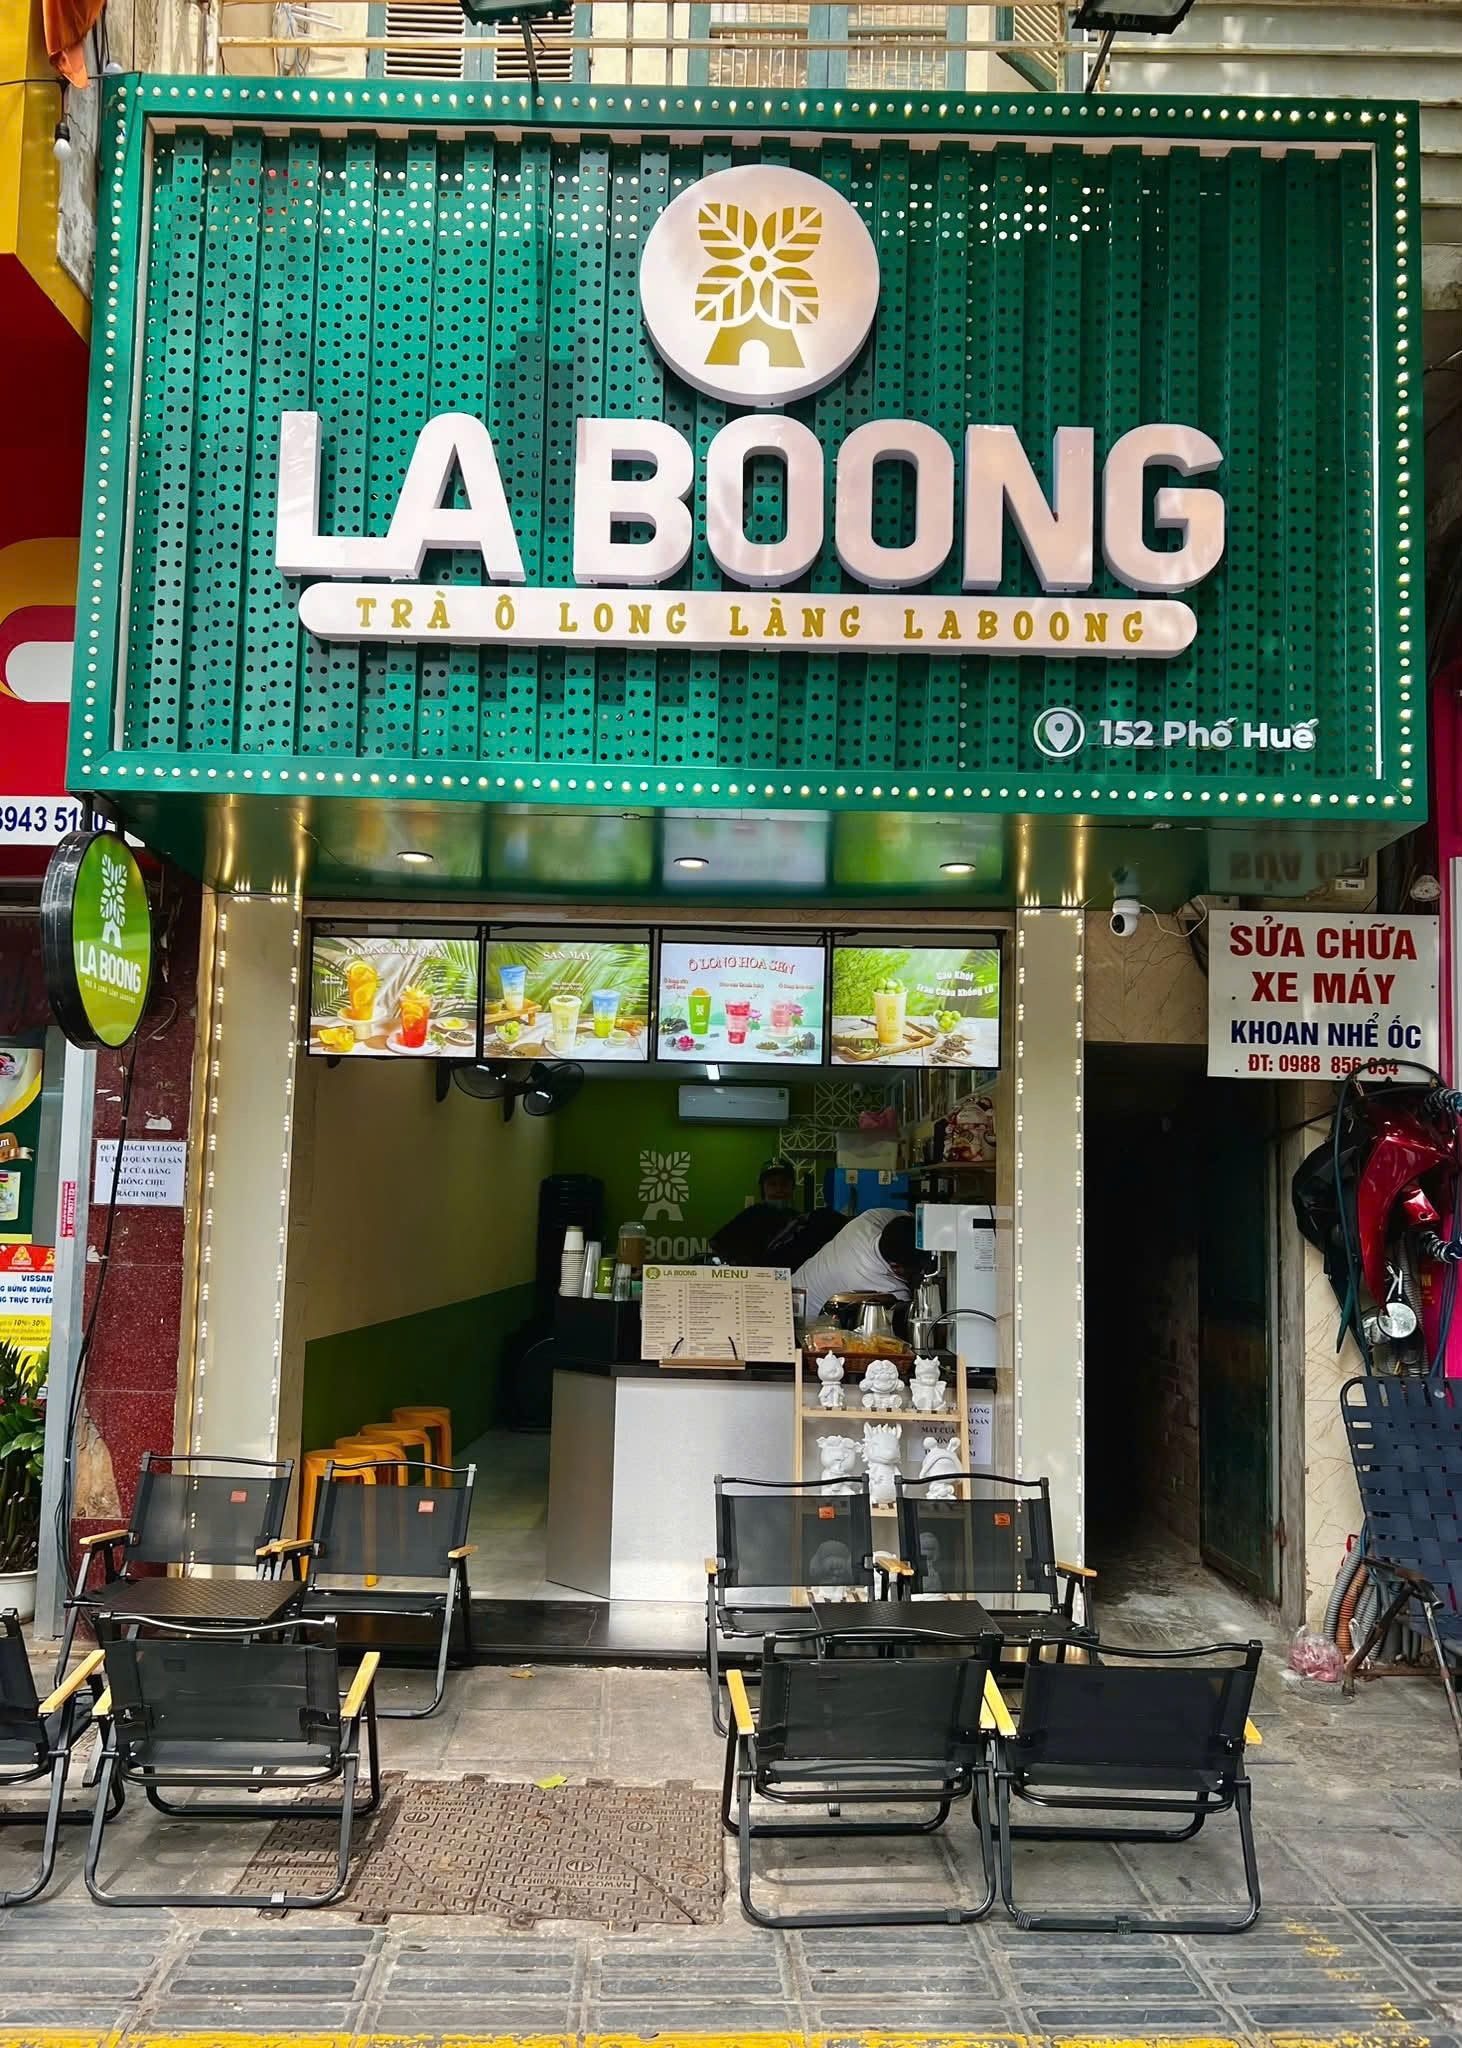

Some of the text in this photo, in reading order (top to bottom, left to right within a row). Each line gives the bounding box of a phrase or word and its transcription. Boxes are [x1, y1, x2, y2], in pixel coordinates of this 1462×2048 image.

[275, 411, 1226, 592] LA BOONG
[356, 591, 1144, 642] TRÀ Ô LONG LÀNG LABOONG
[1099, 717, 1319, 749] 152 Phố Huế
[1230, 915, 1418, 961] SỬA CHỮA
[80, 940, 97, 978] LA
[99, 949, 142, 994] BOONG
[1251, 967, 1396, 1005] XE MÁY
[1231, 1012, 1422, 1049] KHOAN NHỂ ỐC
[1247, 1054, 1273, 1073] ĐT:
[1278, 1055, 1321, 1073] 0988
[1330, 1056, 1362, 1074] 856
[21, 1274, 53, 1282] VISSAN
[711, 1269, 749, 1279] MENU
